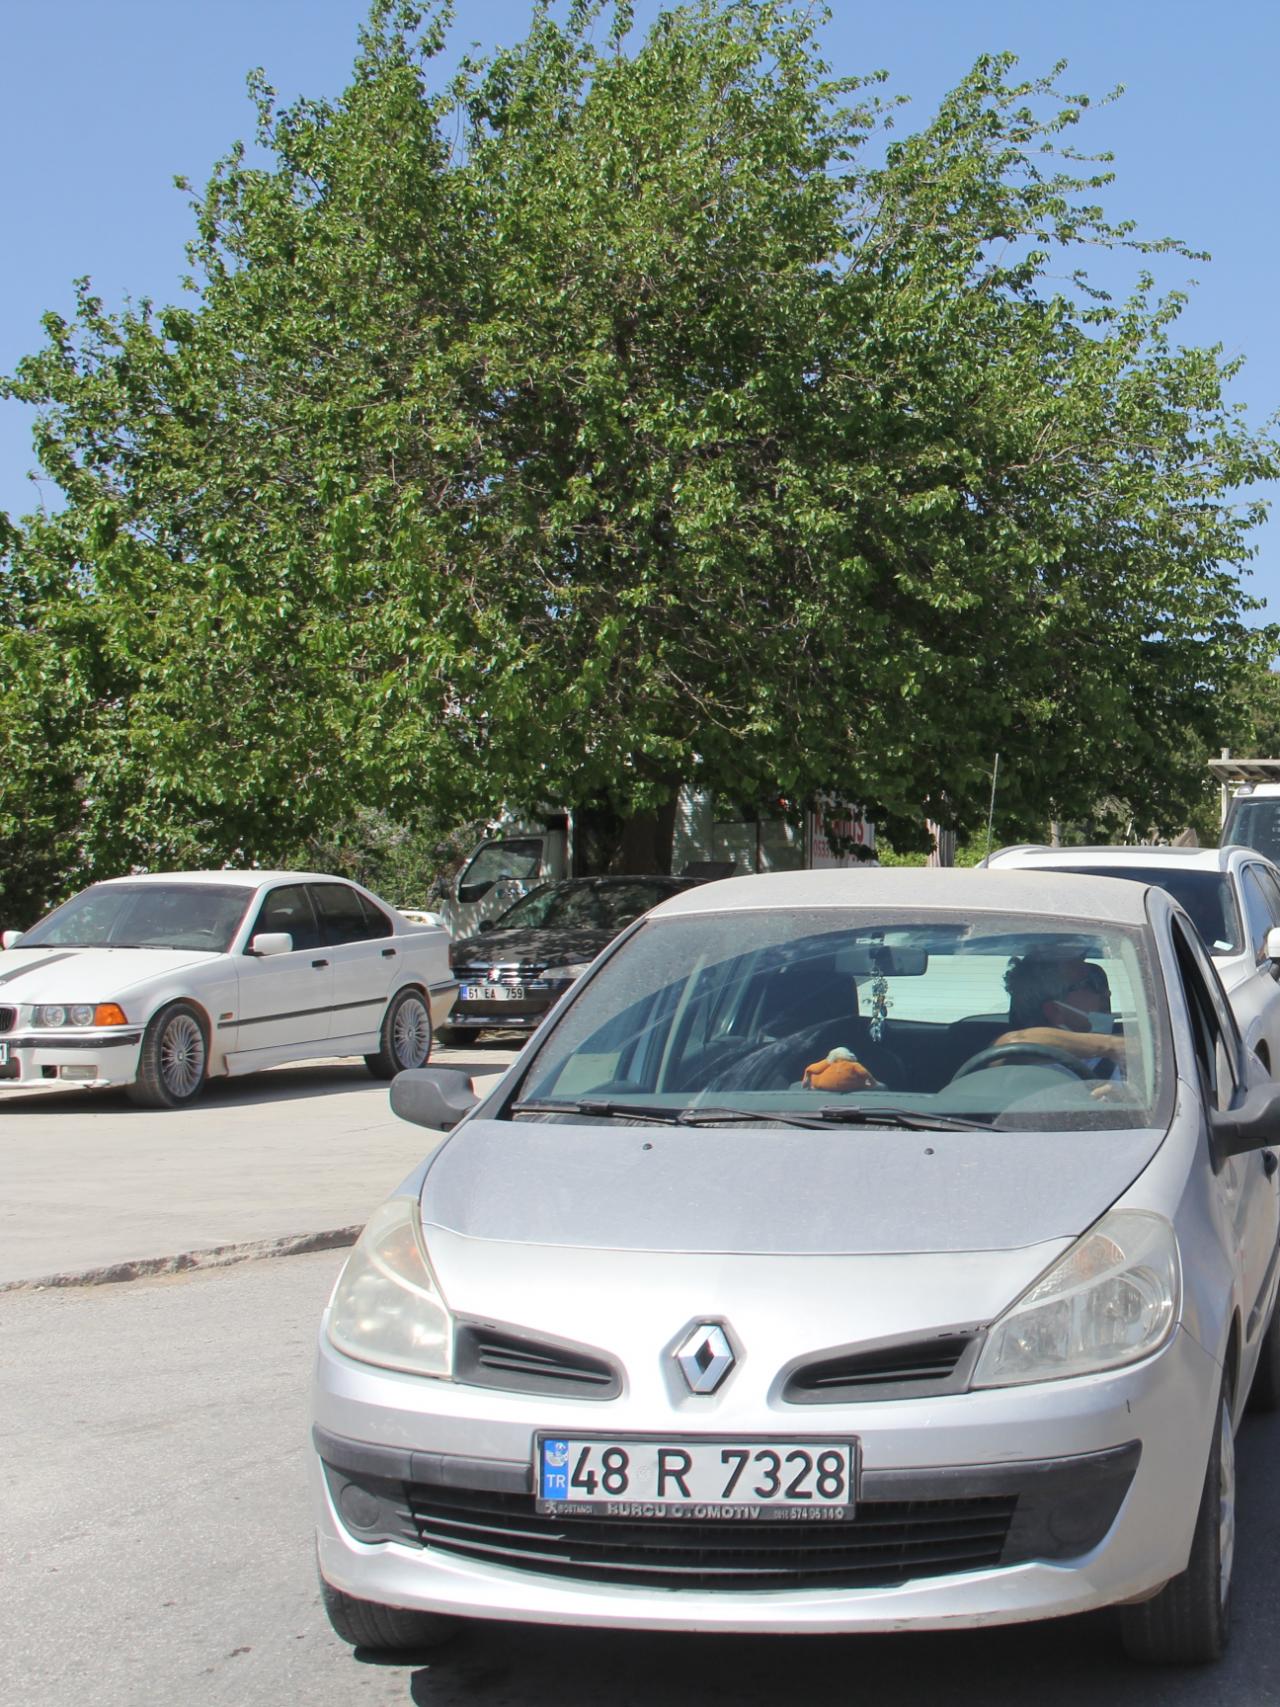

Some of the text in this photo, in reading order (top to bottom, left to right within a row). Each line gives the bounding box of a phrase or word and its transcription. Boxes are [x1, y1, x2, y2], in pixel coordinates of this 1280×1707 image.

[468, 988, 478, 999] 61
[484, 988, 496, 999] EA
[505, 988, 523, 999] 759
[570, 1446, 846, 1500] 48 R 7328
[547, 1474, 566, 1489] TR
[607, 1502, 666, 1517] BURCU
